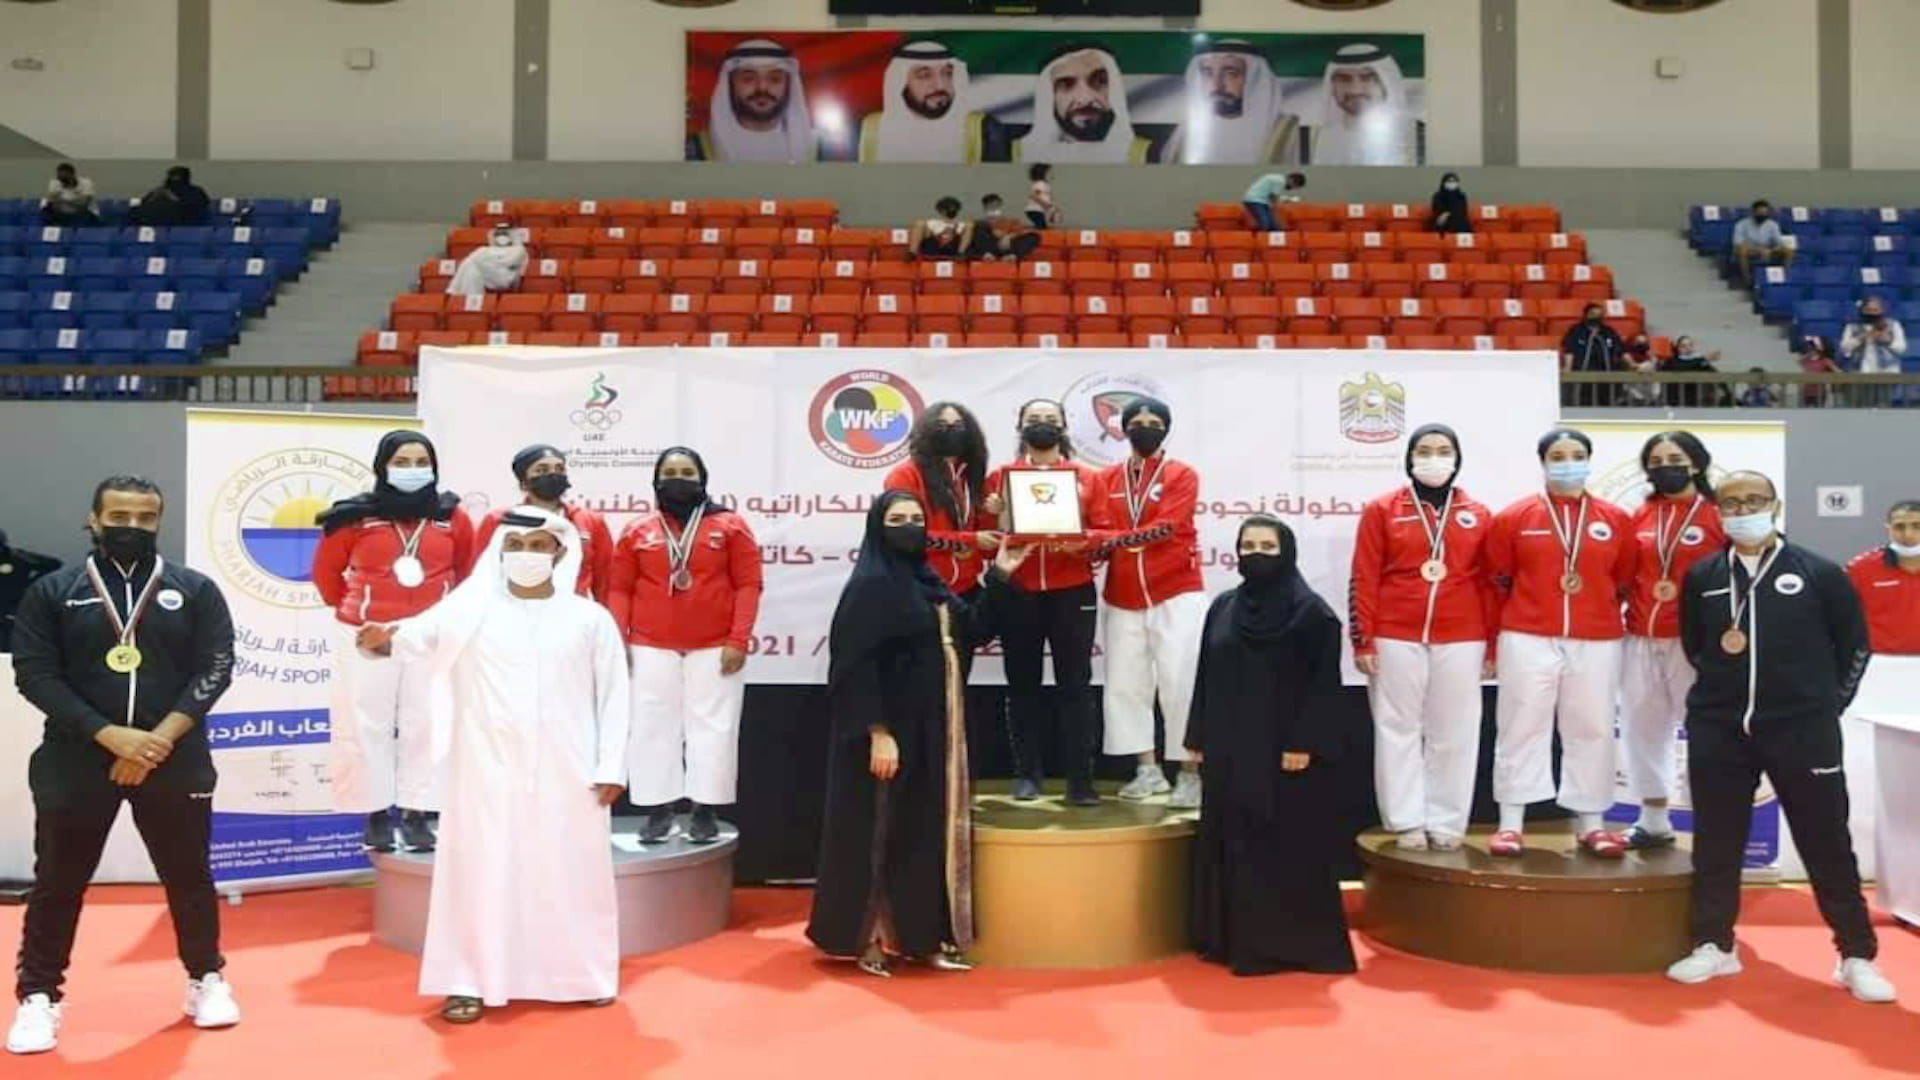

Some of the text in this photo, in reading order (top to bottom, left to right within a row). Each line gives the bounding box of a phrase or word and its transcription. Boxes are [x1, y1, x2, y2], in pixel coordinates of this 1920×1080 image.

[840, 409, 896, 430] WKF
[583, 433, 606, 442] UAE
[568, 460, 609, 468] Olympic
[746, 635, 795, 656] 021
